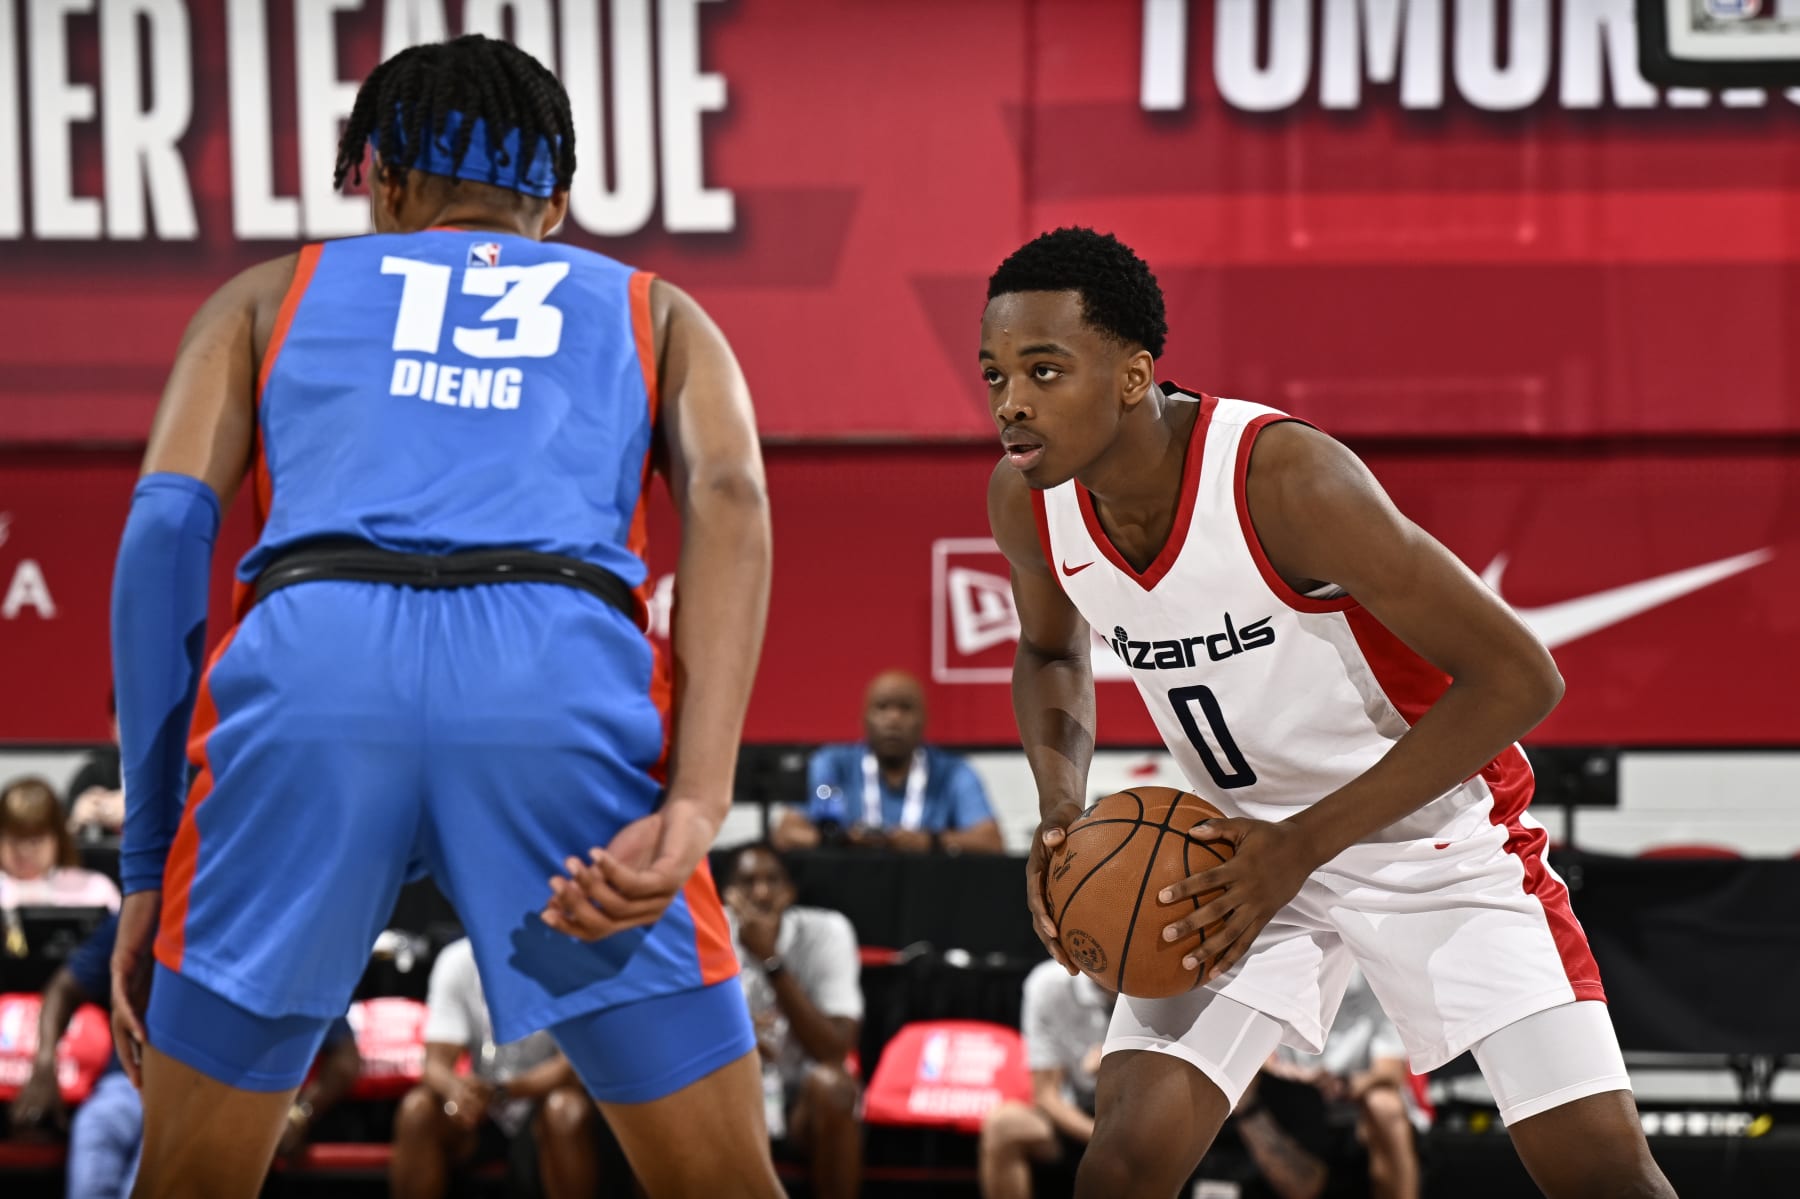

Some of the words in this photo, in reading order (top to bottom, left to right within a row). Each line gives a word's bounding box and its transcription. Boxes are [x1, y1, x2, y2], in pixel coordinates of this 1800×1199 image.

[0, 0, 200, 239] ER
[225, 0, 735, 239] LEUE
[380, 255, 571, 358] 13
[389, 358, 523, 410] DIENG
[1167, 684, 1257, 789] 0
